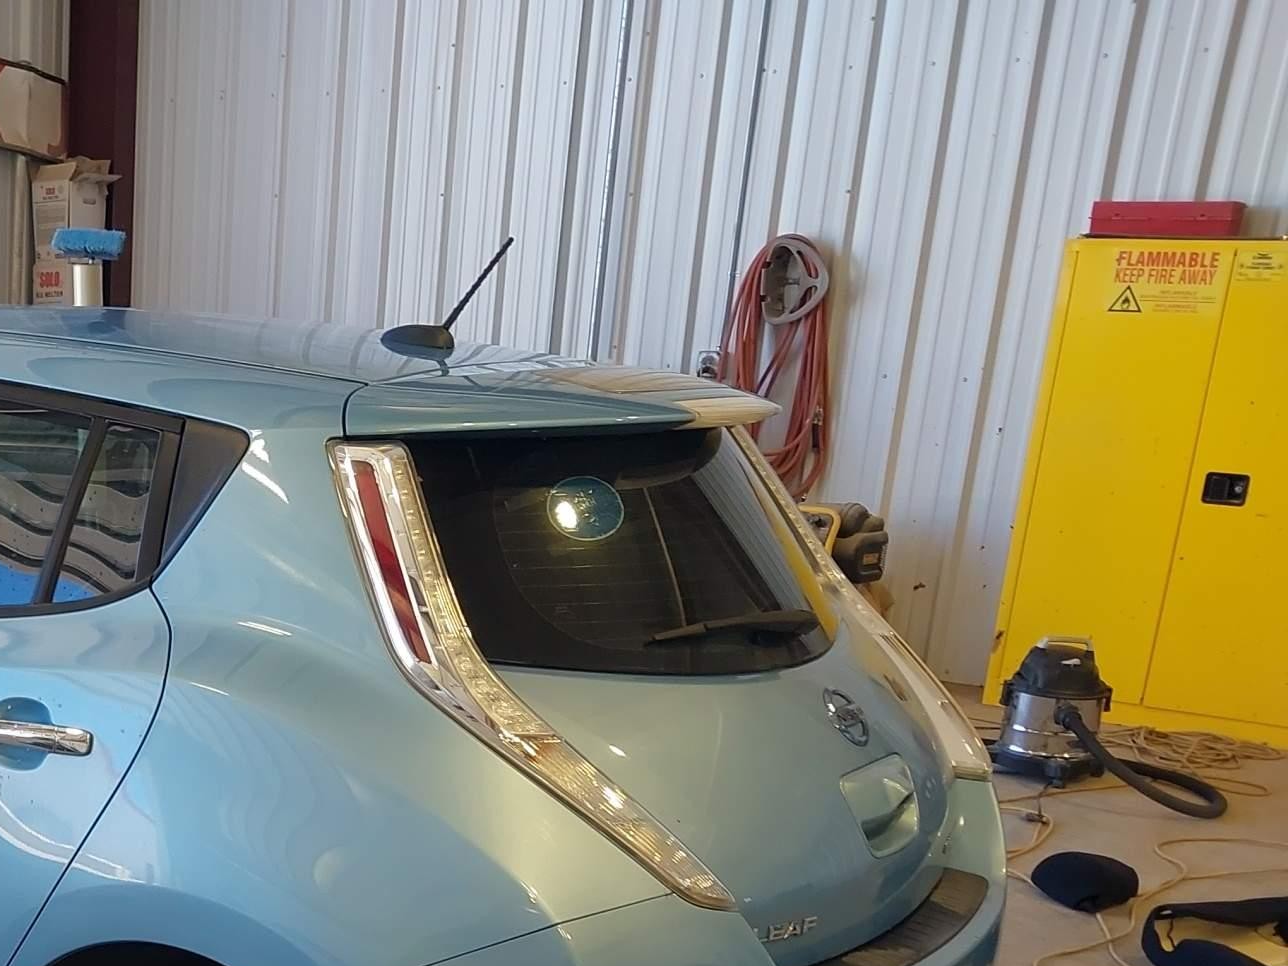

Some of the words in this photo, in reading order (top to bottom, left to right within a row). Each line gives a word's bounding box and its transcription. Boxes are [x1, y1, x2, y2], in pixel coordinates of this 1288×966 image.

[1116, 251, 1220, 268] FLAMMABLE
[1115, 268, 1144, 283] KEEP
[1147, 268, 1176, 284] FIRE
[1178, 269, 1216, 285] AWAY
